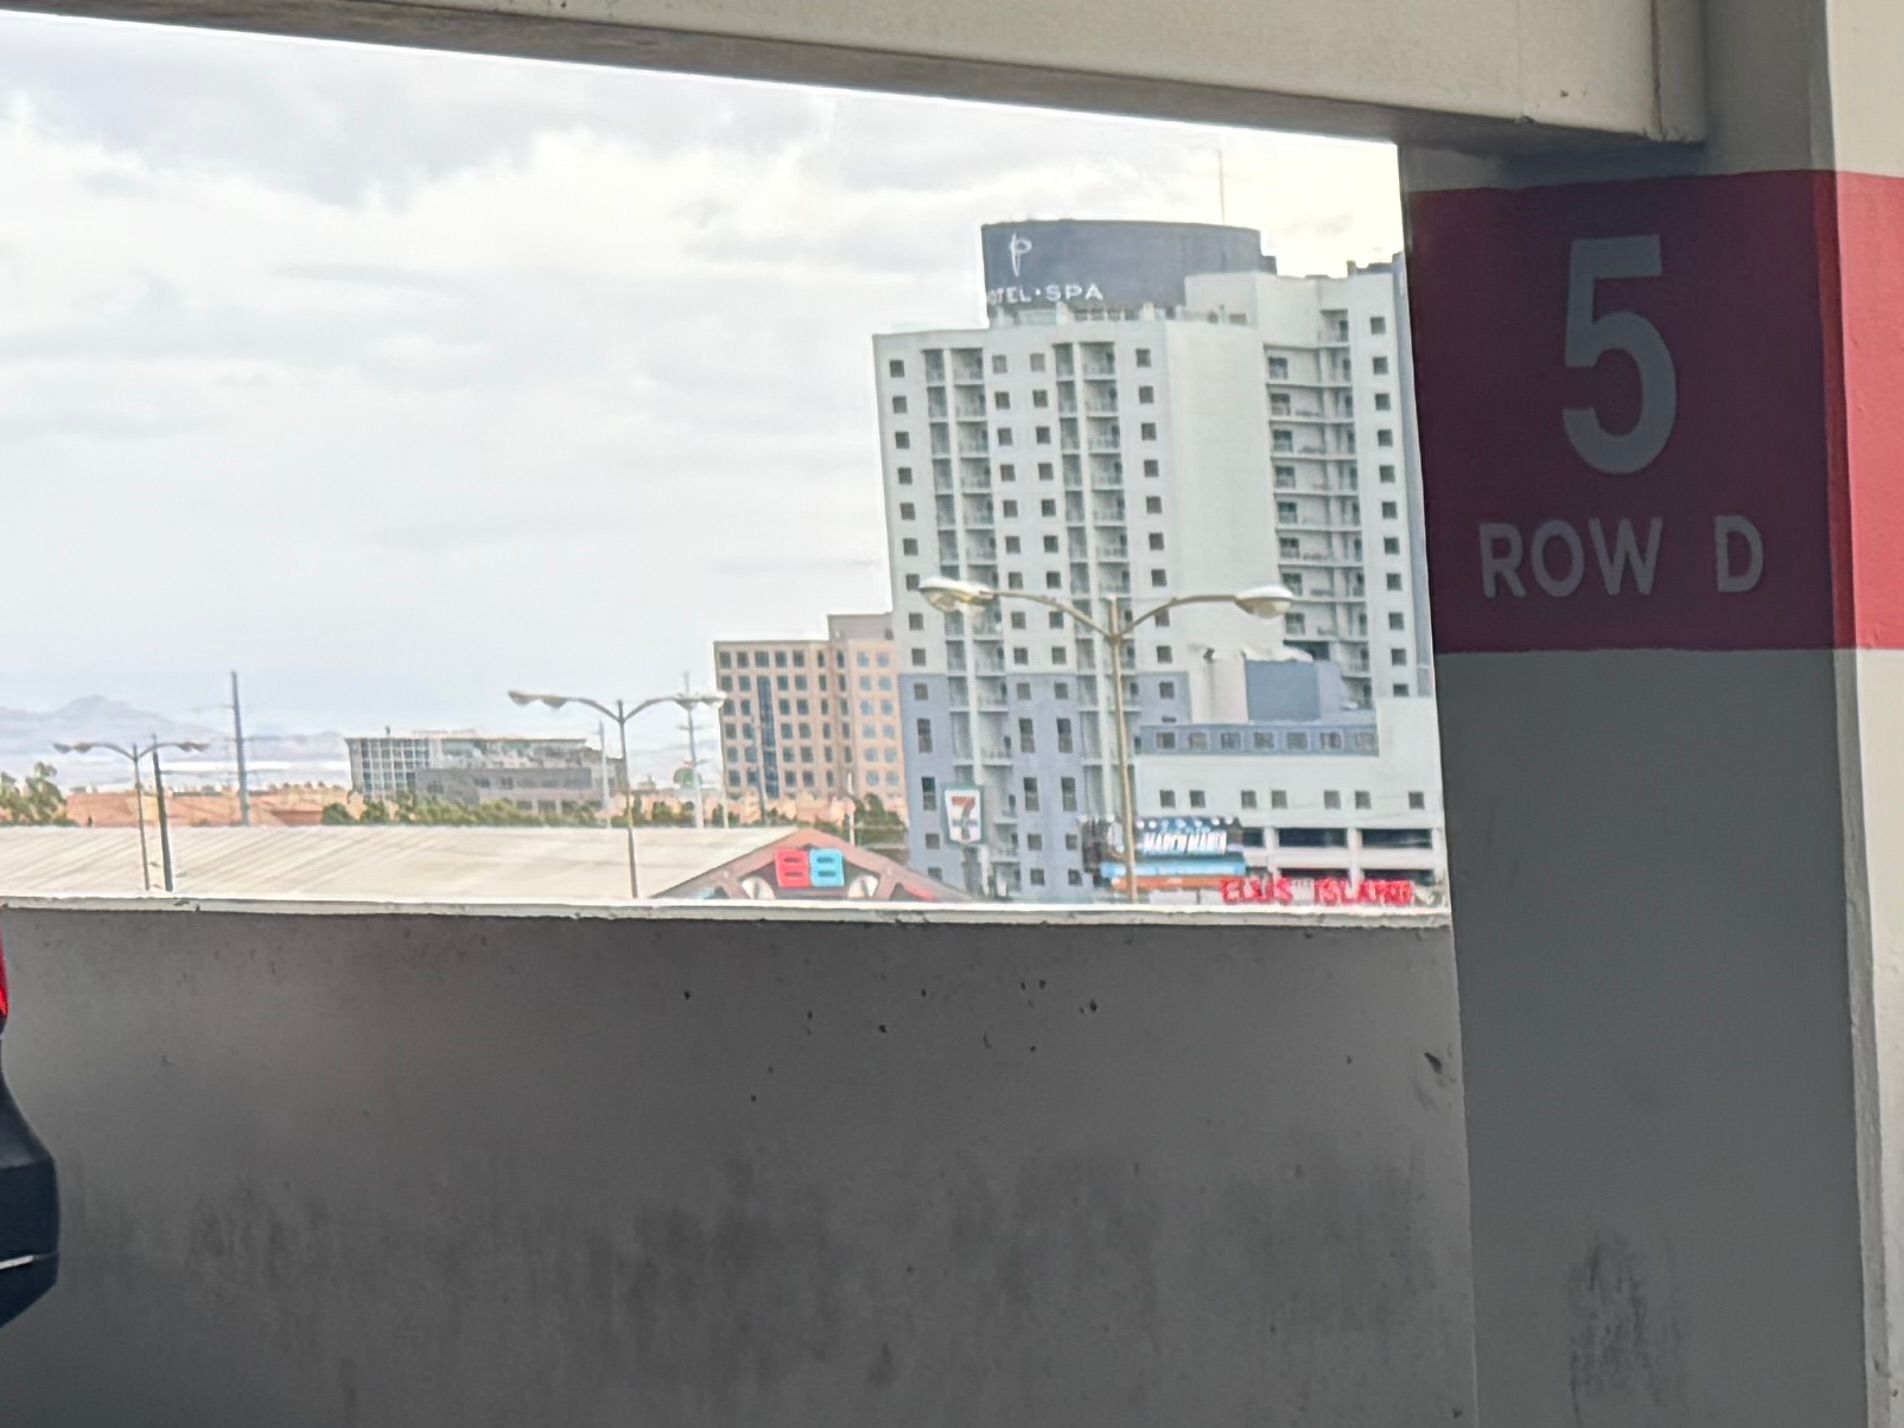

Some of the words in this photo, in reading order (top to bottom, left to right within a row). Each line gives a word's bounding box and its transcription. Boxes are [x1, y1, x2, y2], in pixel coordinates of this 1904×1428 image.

[1045, 283, 1104, 302] SPA
[1561, 233, 1677, 475] 5
[1478, 516, 1661, 598] ROW
[1714, 514, 1764, 593] D
[951, 796, 976, 840] 7
